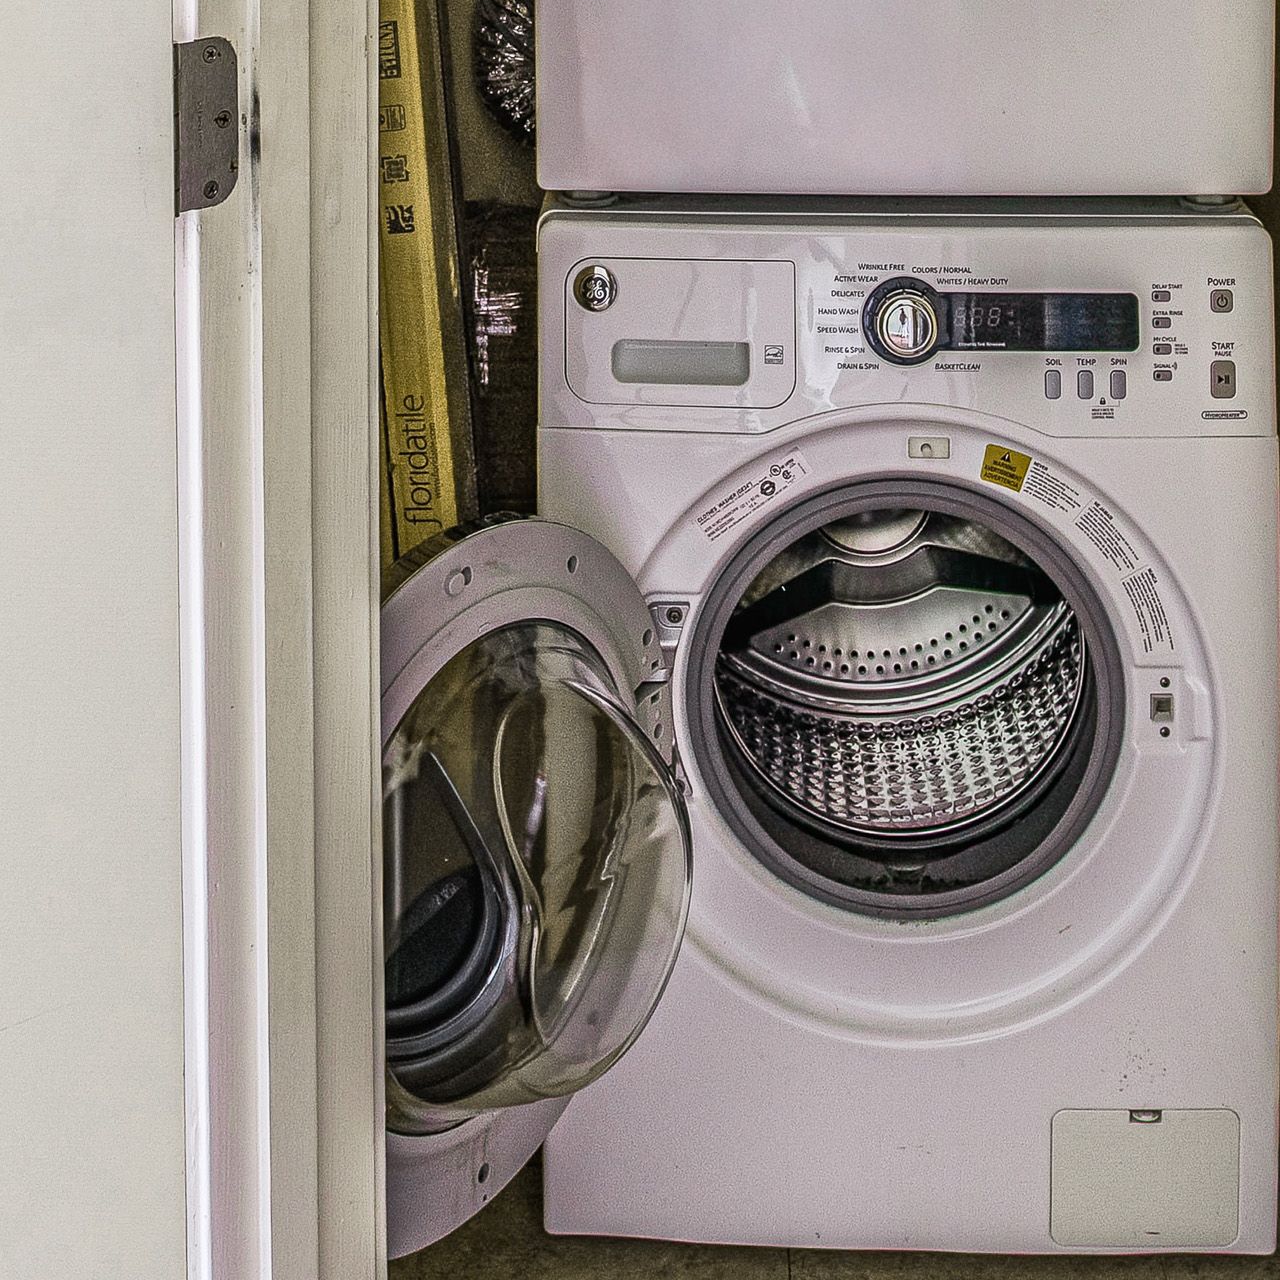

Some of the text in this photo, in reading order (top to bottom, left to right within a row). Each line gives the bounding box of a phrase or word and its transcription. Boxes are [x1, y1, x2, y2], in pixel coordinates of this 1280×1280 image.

[1207, 278, 1236, 286] POWER
[1212, 342, 1235, 350] START
[403, 394, 444, 528] floridatile
[1033, 460, 1048, 471] NEVER
[696, 506, 718, 522] CLOTHES
